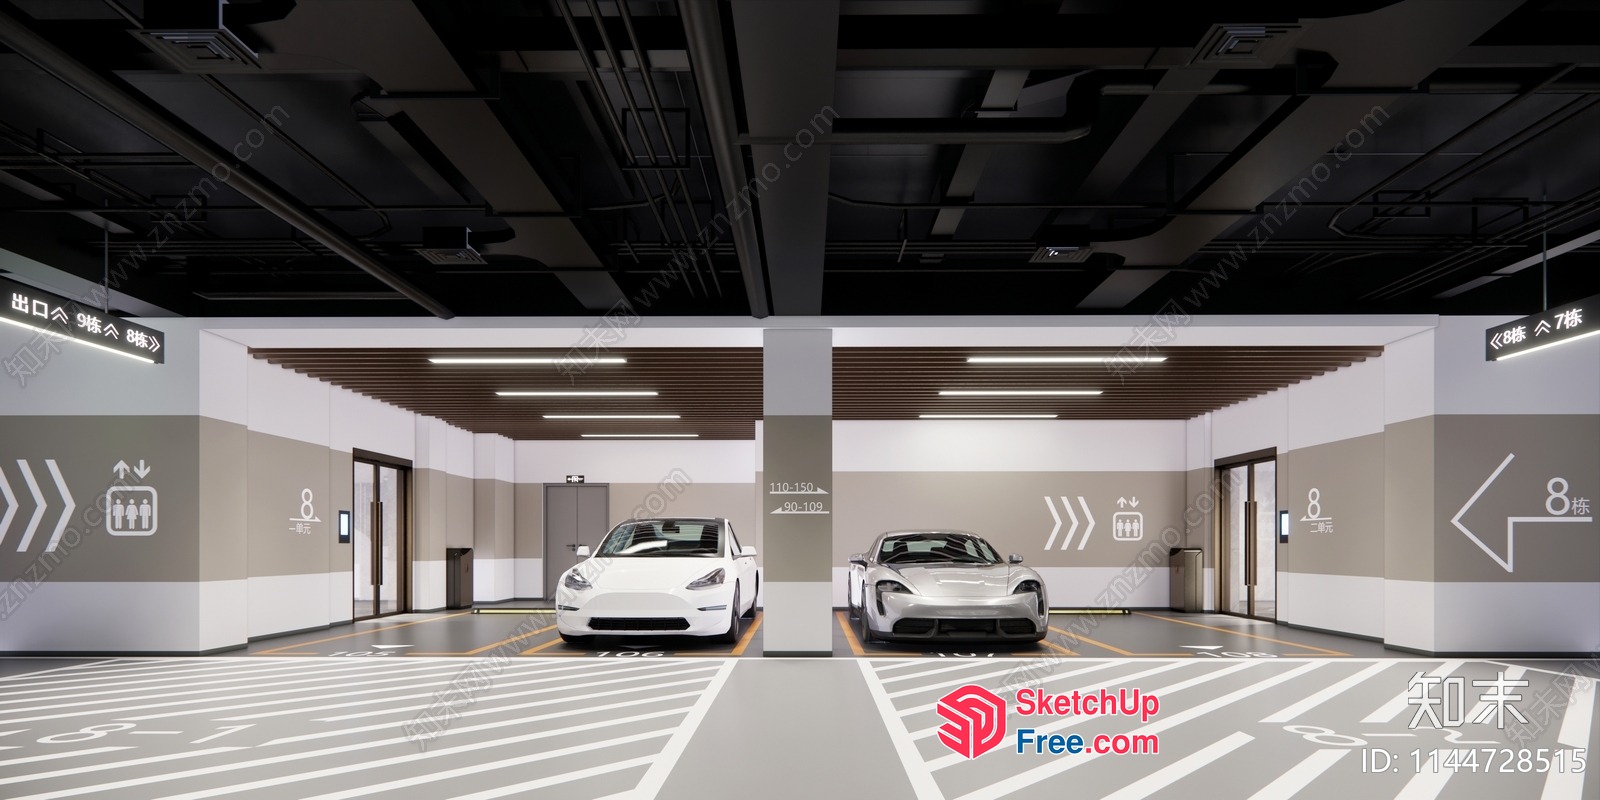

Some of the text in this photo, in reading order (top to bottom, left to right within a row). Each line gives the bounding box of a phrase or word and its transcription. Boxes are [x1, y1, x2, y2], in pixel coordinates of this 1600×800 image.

[11, 292, 149, 348] 出口 9栋 8栋
[1503, 308, 1583, 344] 8栋 7栋
[769, 482, 814, 492] 110-150
[1545, 477, 1590, 516] 8栋
[300, 488, 314, 519] 8
[784, 501, 823, 512] 90-109
[1307, 488, 1321, 519] 8
[289, 522, 311, 535] 一单元
[1310, 521, 1334, 533] 二单元
